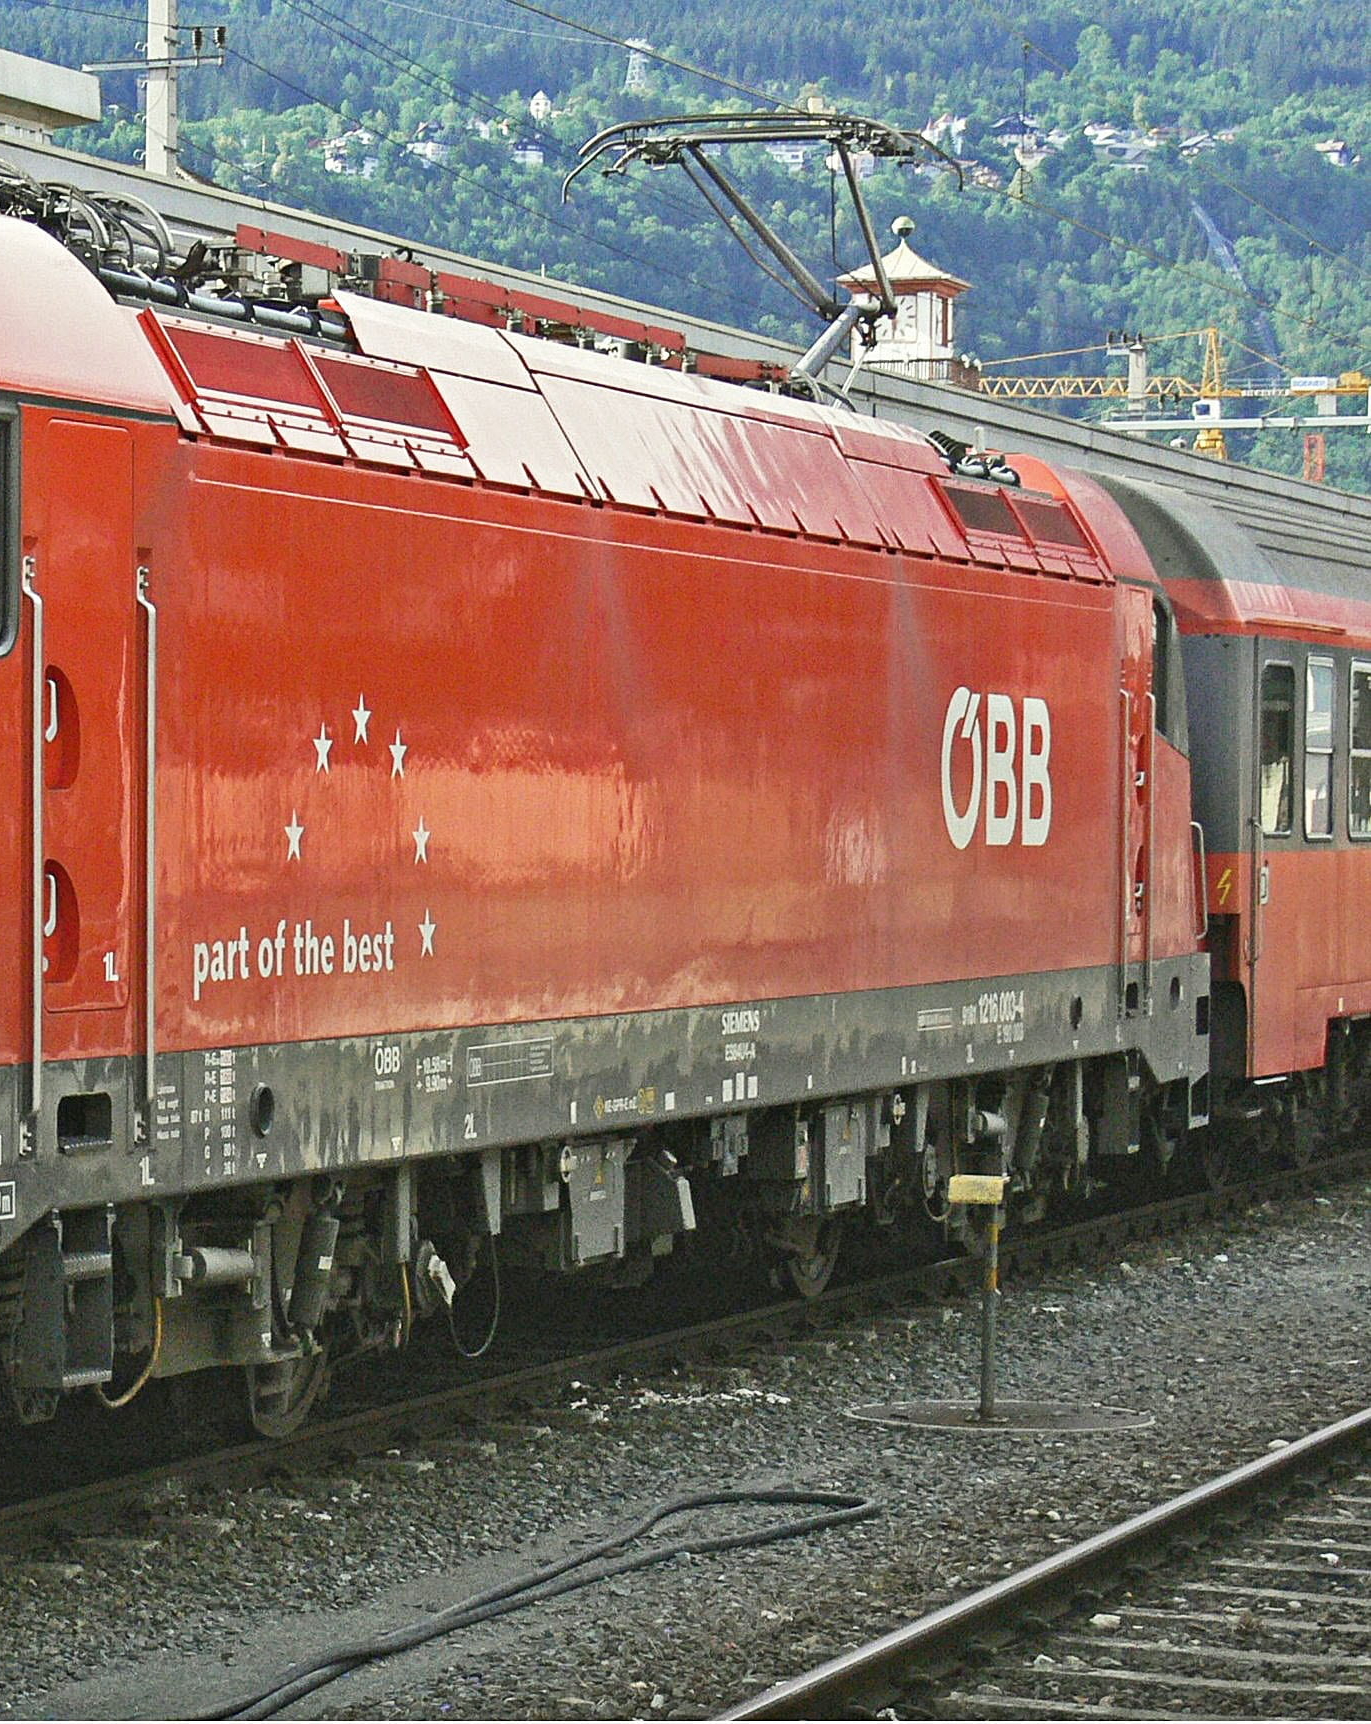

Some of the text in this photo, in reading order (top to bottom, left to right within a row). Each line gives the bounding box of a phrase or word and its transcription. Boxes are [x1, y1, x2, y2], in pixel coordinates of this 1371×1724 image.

[940, 686, 1053, 850] ÖBB
[193, 918, 395, 1002] part of the best
[721, 1009, 761, 1036] SIEMENS
[374, 1040, 401, 1076] ÖBB
